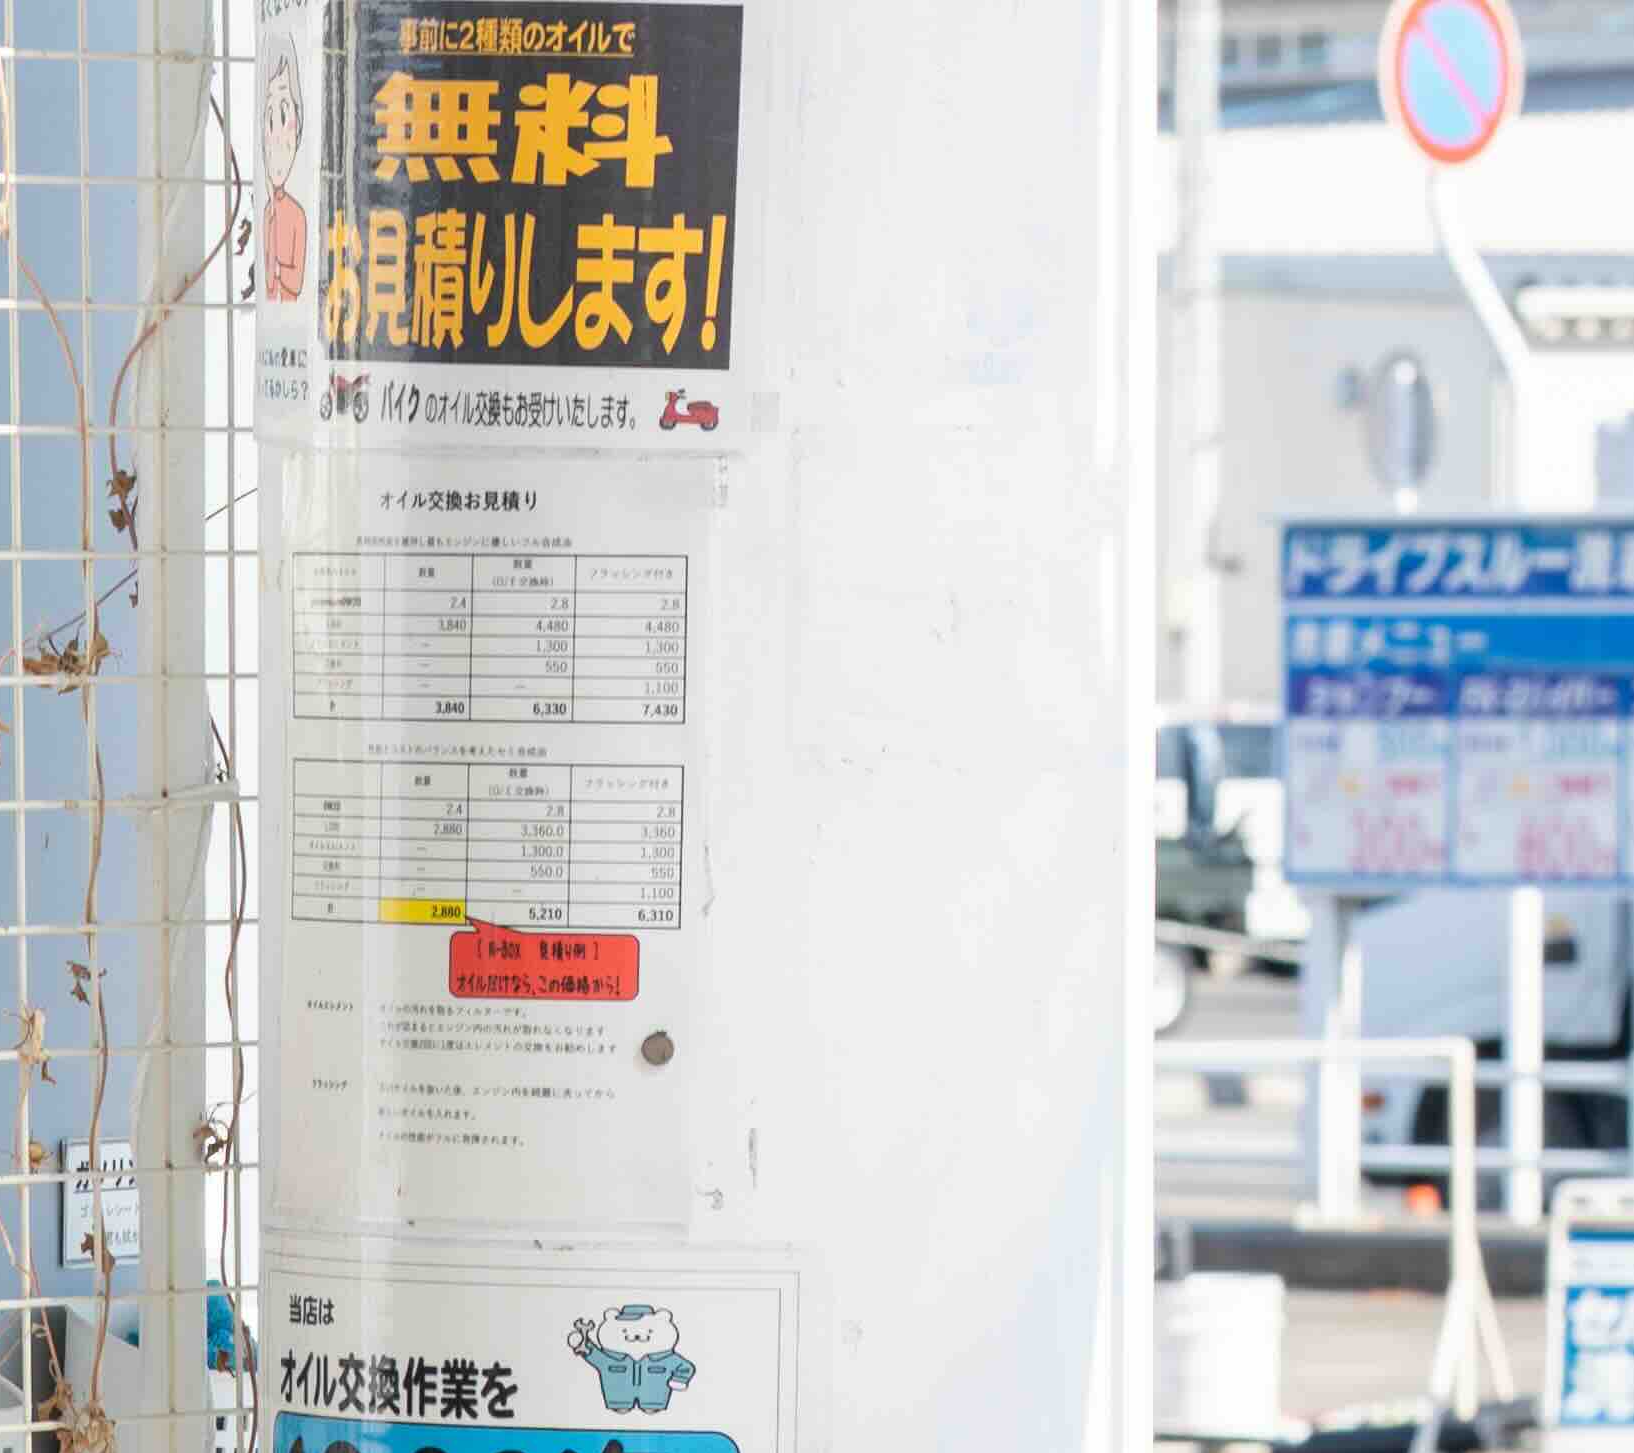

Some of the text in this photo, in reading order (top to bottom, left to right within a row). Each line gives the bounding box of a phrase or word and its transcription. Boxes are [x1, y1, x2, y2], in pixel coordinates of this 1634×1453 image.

[399, 16, 636, 54] 事前に2種類のオイルで
[372, 70, 674, 189] 無料
[326, 208, 728, 355] お見積りします!
[379, 489, 540, 514] オイル交換お見積り
[536, 620, 570, 634] 4,480
[644, 621, 681, 635] 4,480
[546, 661, 568, 673] 550
[644, 681, 679, 695] 1,100
[532, 702, 567, 716] 6,330
[641, 704, 678, 718] 7,430
[650, 866, 675, 880] 550
[640, 886, 674, 900] 1,100
[528, 906, 563, 922] 5,210
[637, 908, 674, 922] 6,310
[287, 1294, 335, 1326] 当店は
[279, 1348, 519, 1420] オイル交換作業を
